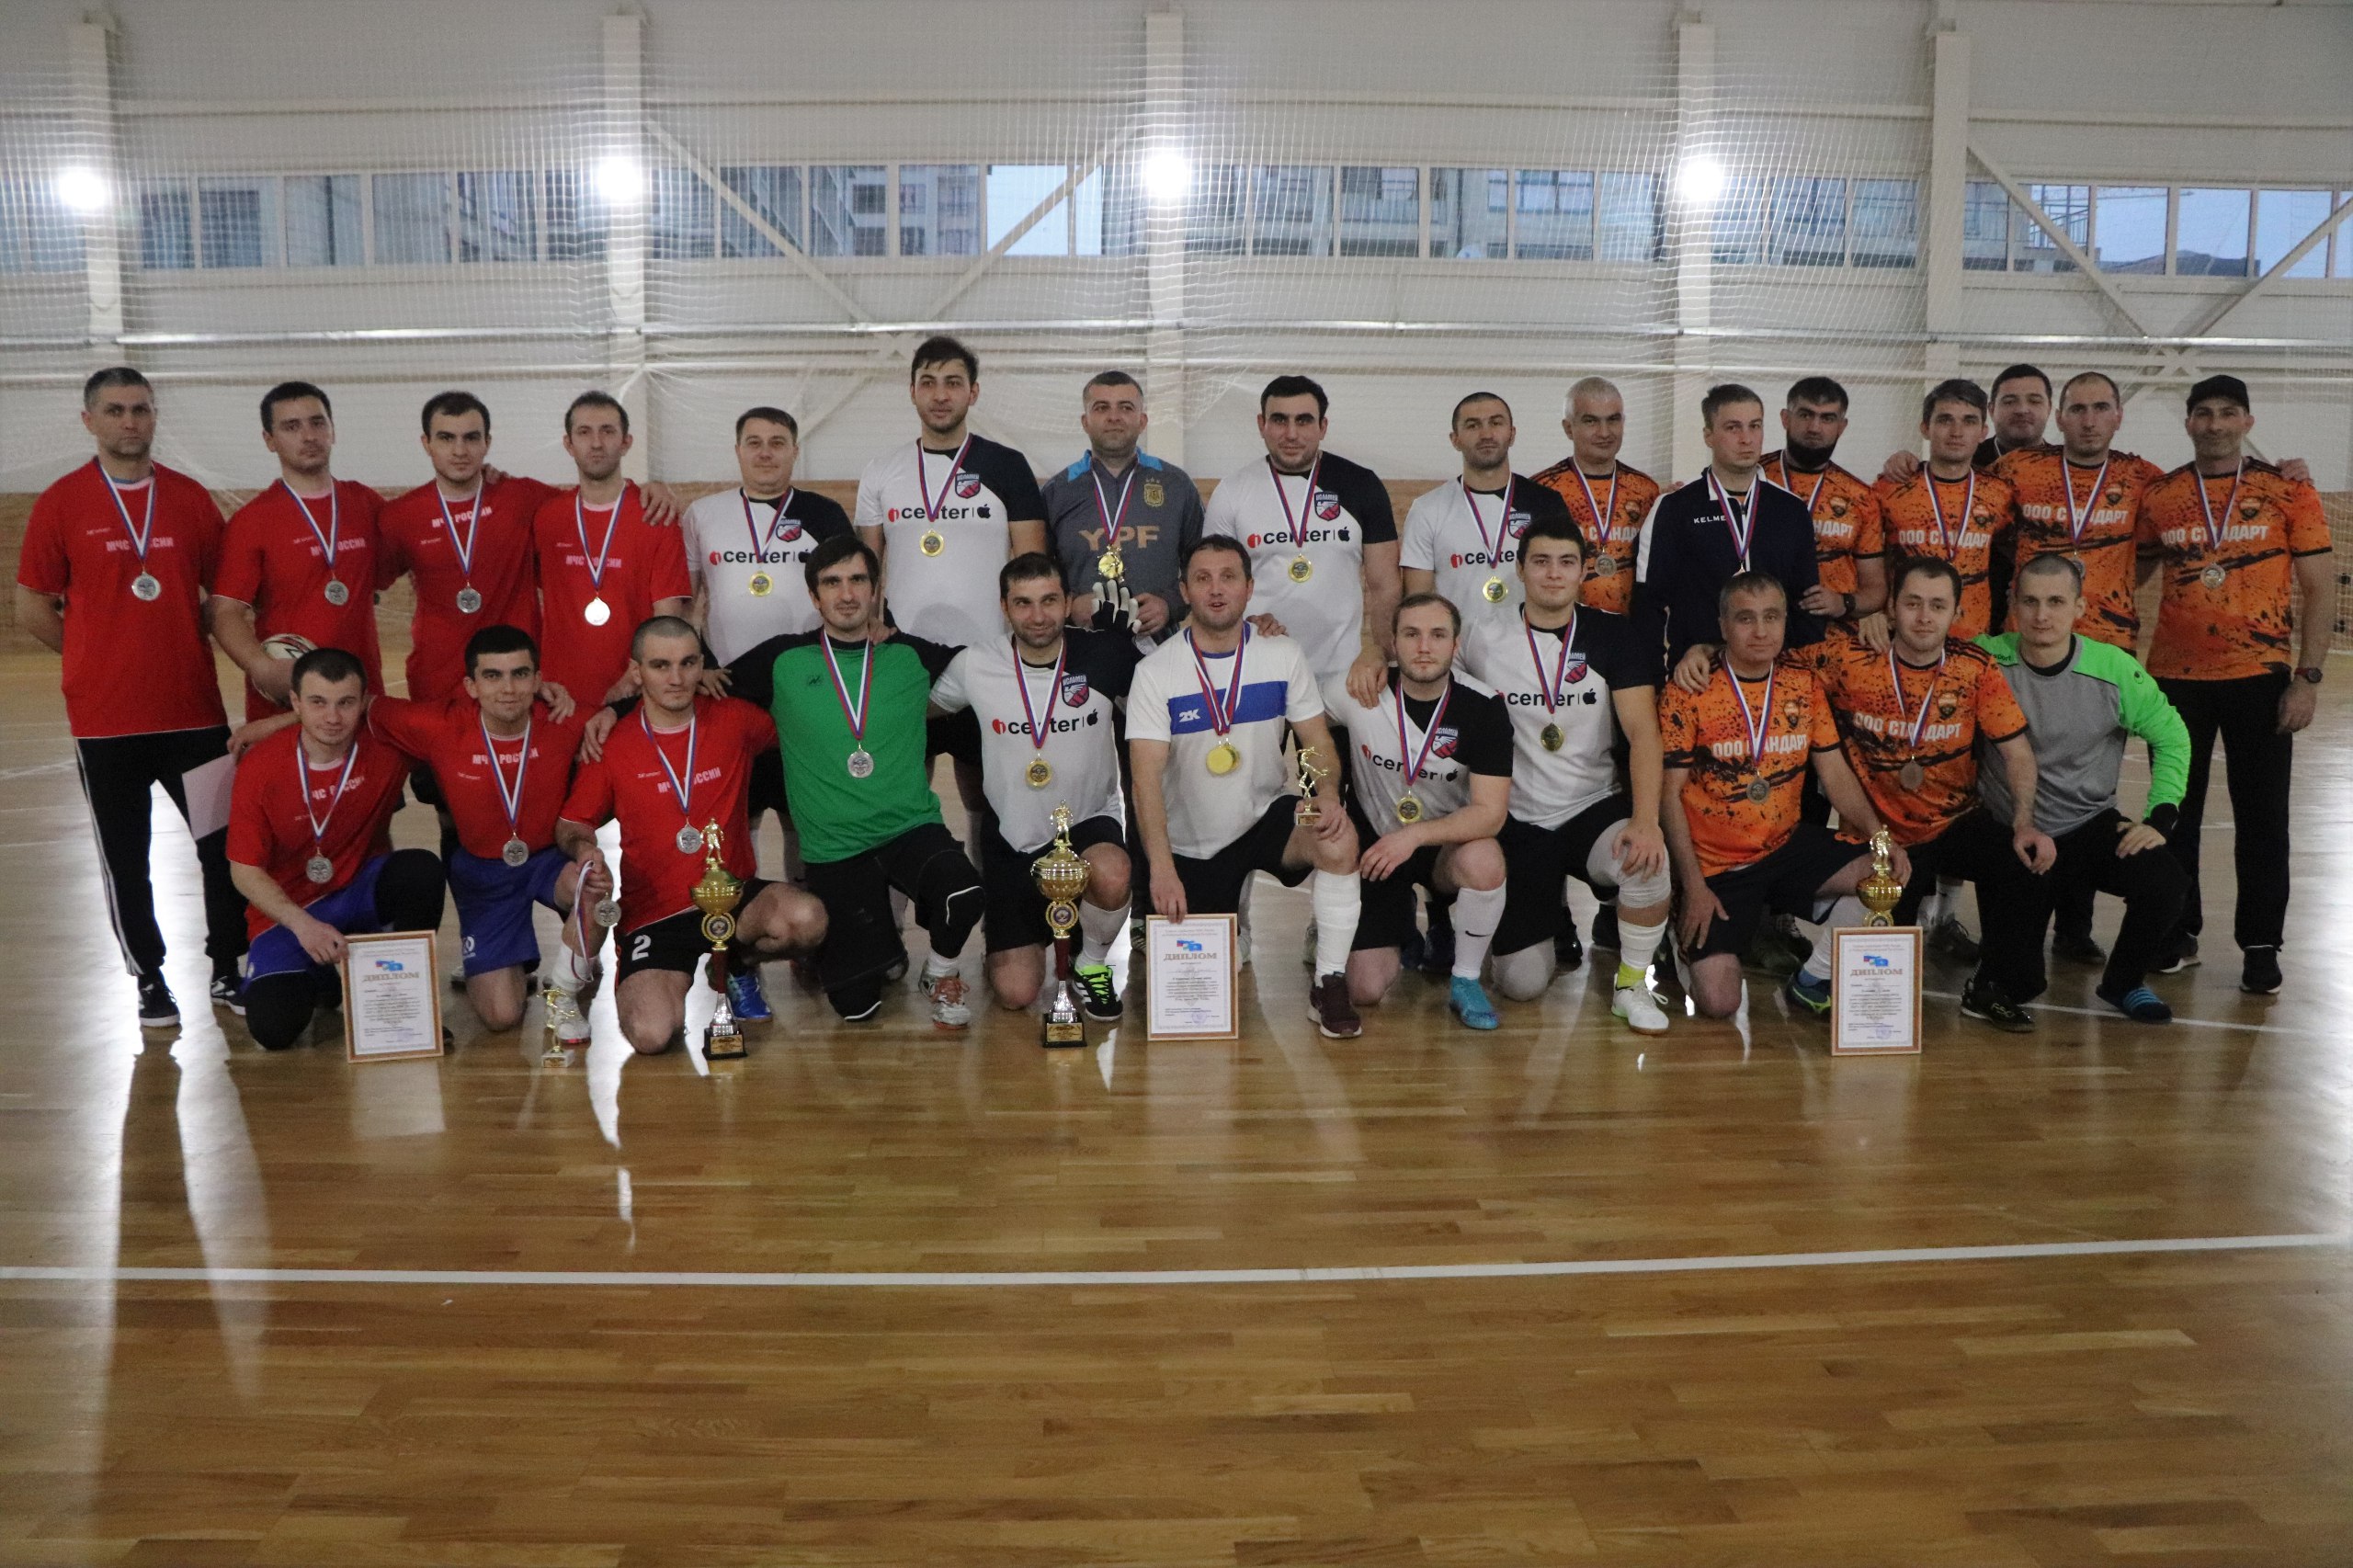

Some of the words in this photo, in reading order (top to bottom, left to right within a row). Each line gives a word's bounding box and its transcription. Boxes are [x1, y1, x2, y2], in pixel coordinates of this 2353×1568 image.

[902, 506, 969, 519] ceter
[1693, 515, 1726, 525] KELME
[1078, 525, 1160, 551] YPF
[1507, 692, 1574, 706] cener
[1007, 717, 1079, 734] ceter
[1712, 739, 1743, 758] ООО
[631, 934, 652, 961] 2
[1163, 952, 1217, 961] ДИПЛОМ
